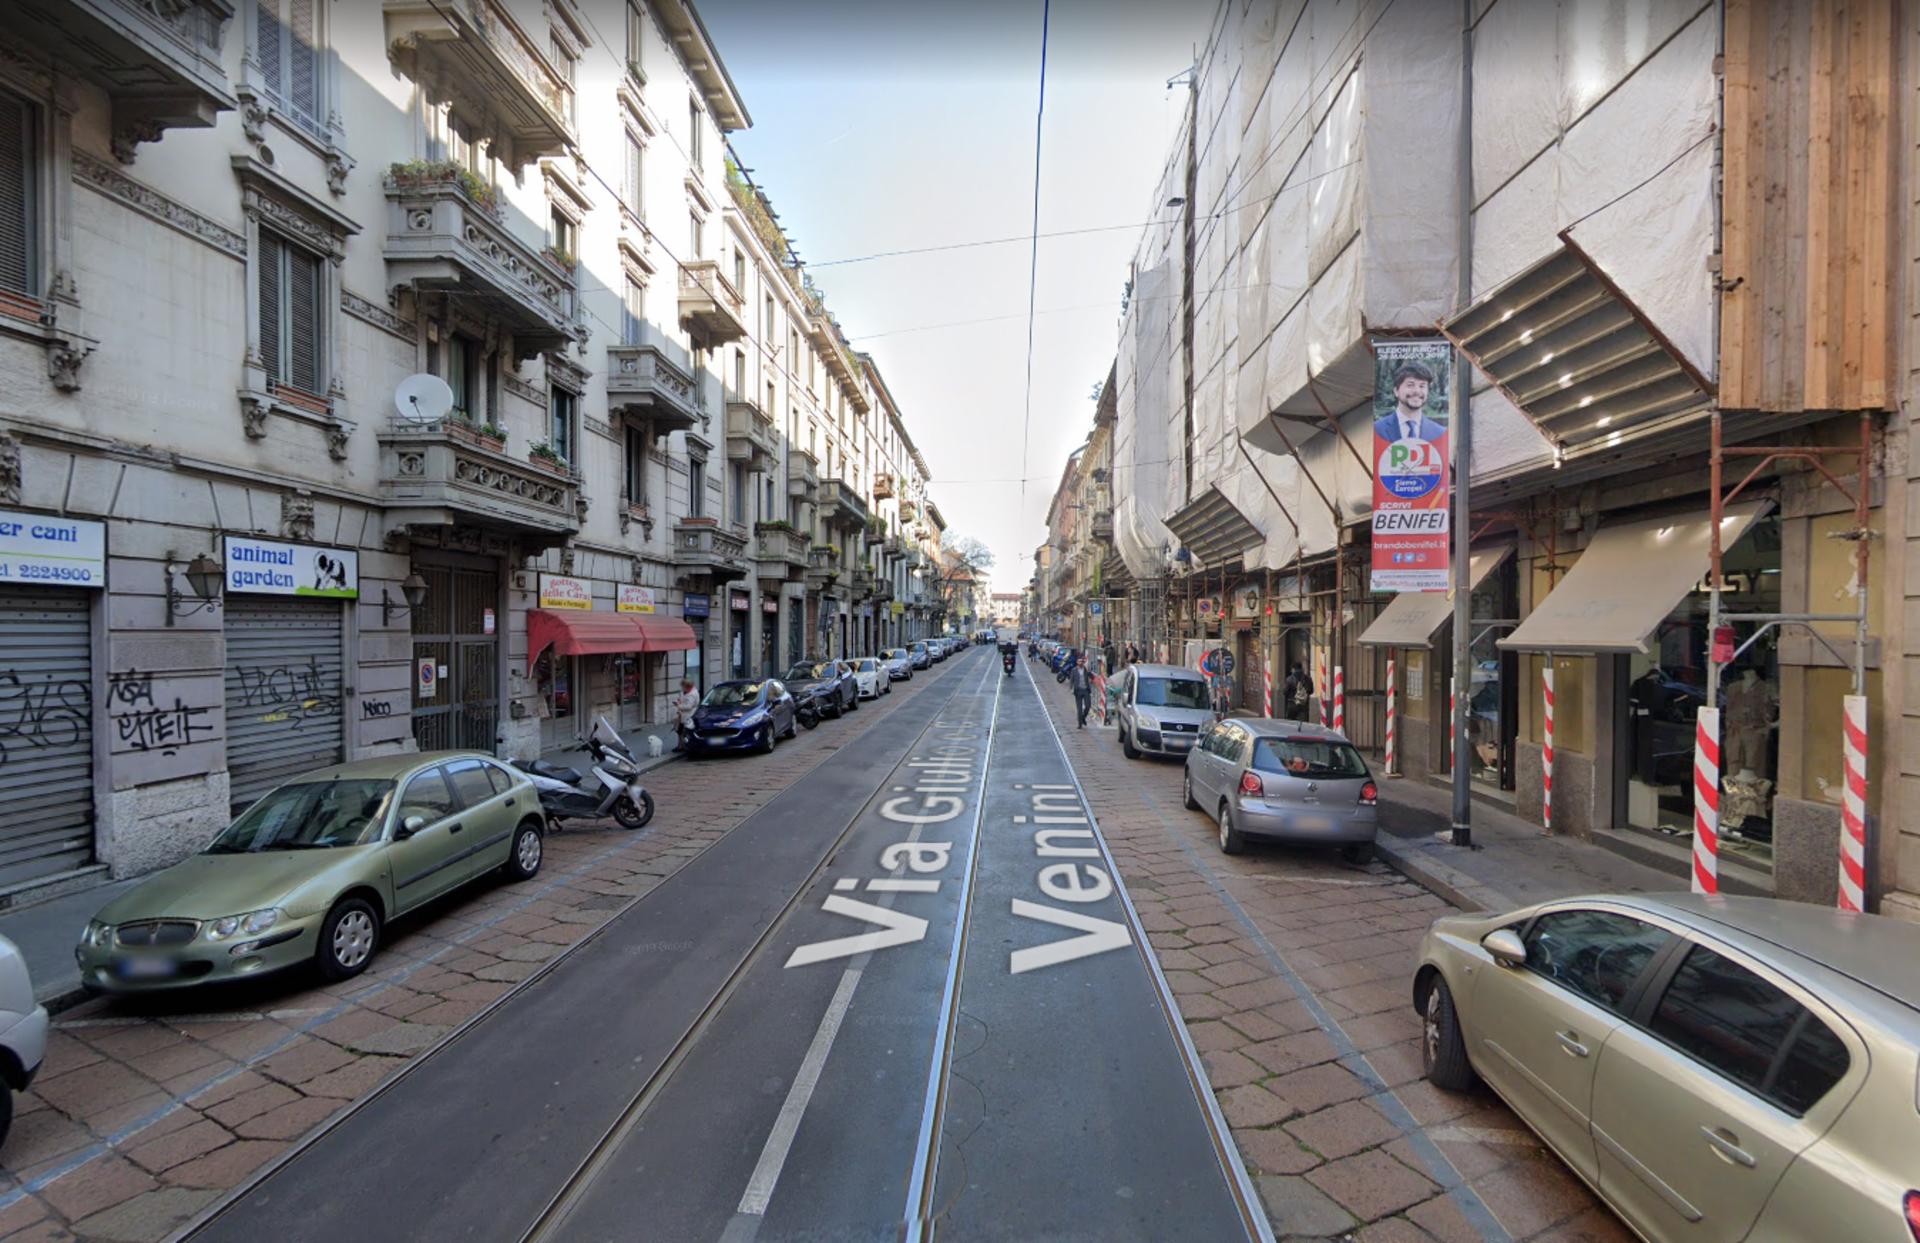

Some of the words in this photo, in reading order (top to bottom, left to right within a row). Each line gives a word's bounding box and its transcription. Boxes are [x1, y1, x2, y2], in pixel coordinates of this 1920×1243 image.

[1375, 513, 1445, 529] BENIFEI
[31, 526, 78, 542] cani
[1374, 541, 1446, 550] brandobenifei.it
[232, 545, 294, 566] animal
[19, 564, 91, 581] 2824900
[232, 569, 294, 588] garden
